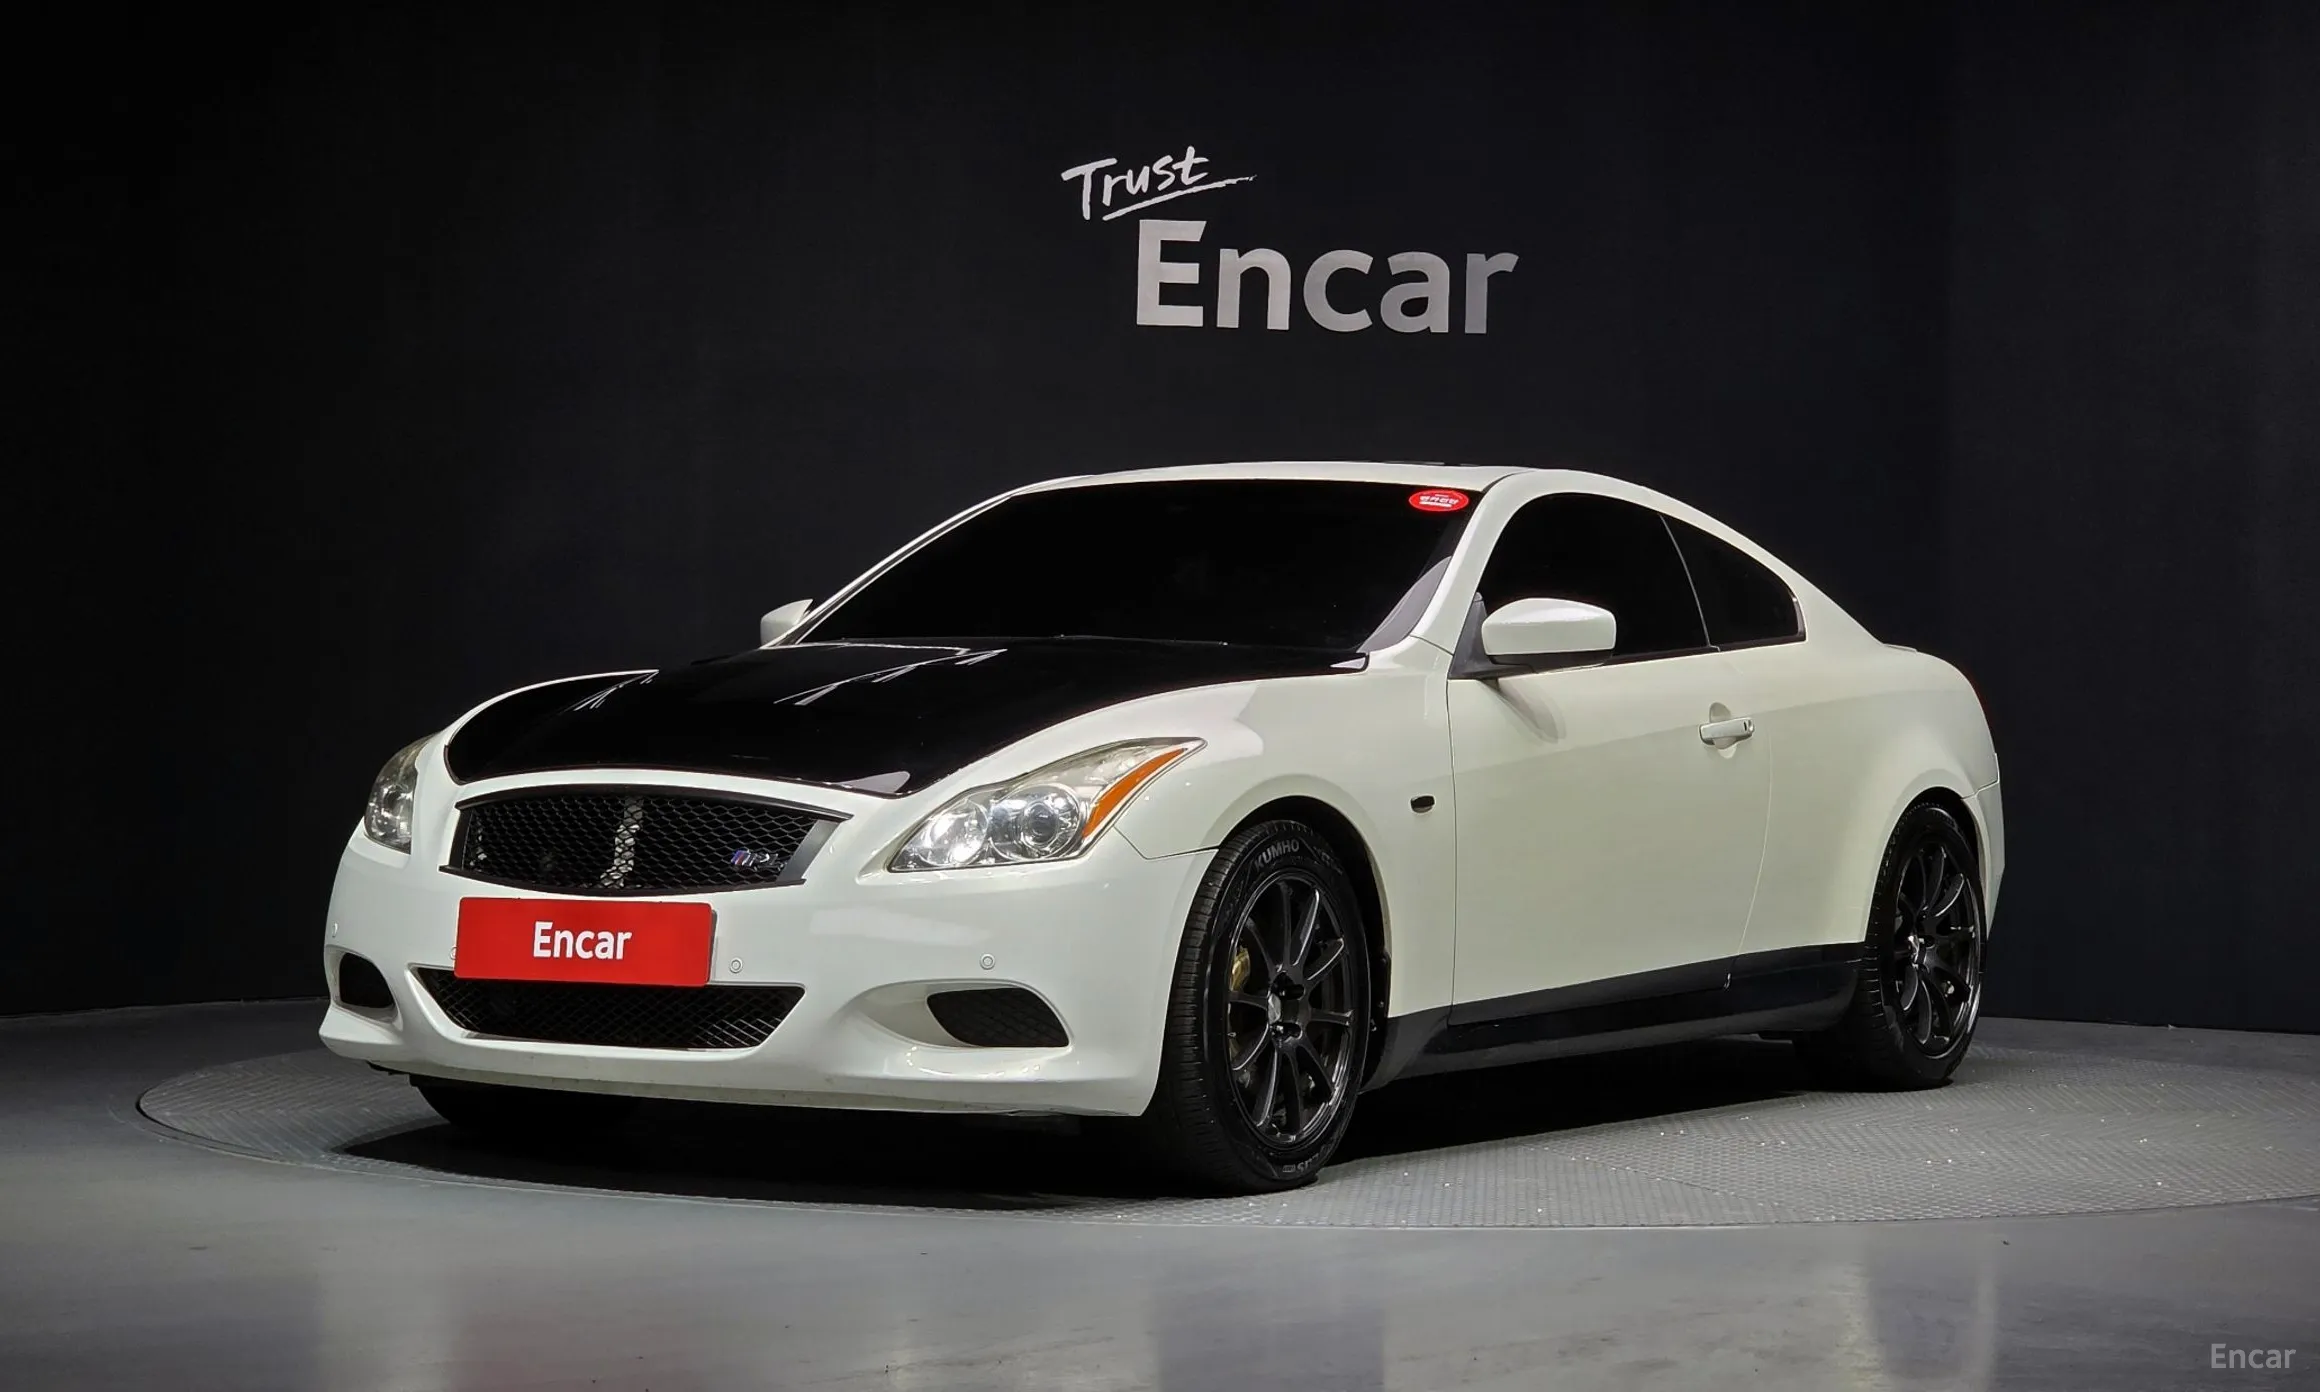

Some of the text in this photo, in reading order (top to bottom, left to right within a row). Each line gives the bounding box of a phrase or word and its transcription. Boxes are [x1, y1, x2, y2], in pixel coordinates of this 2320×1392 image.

[1061, 146, 1210, 221] Trust
[1136, 219, 1520, 334] Encar
[1254, 839, 1300, 871] KUMHO
[533, 921, 633, 960] Encar
